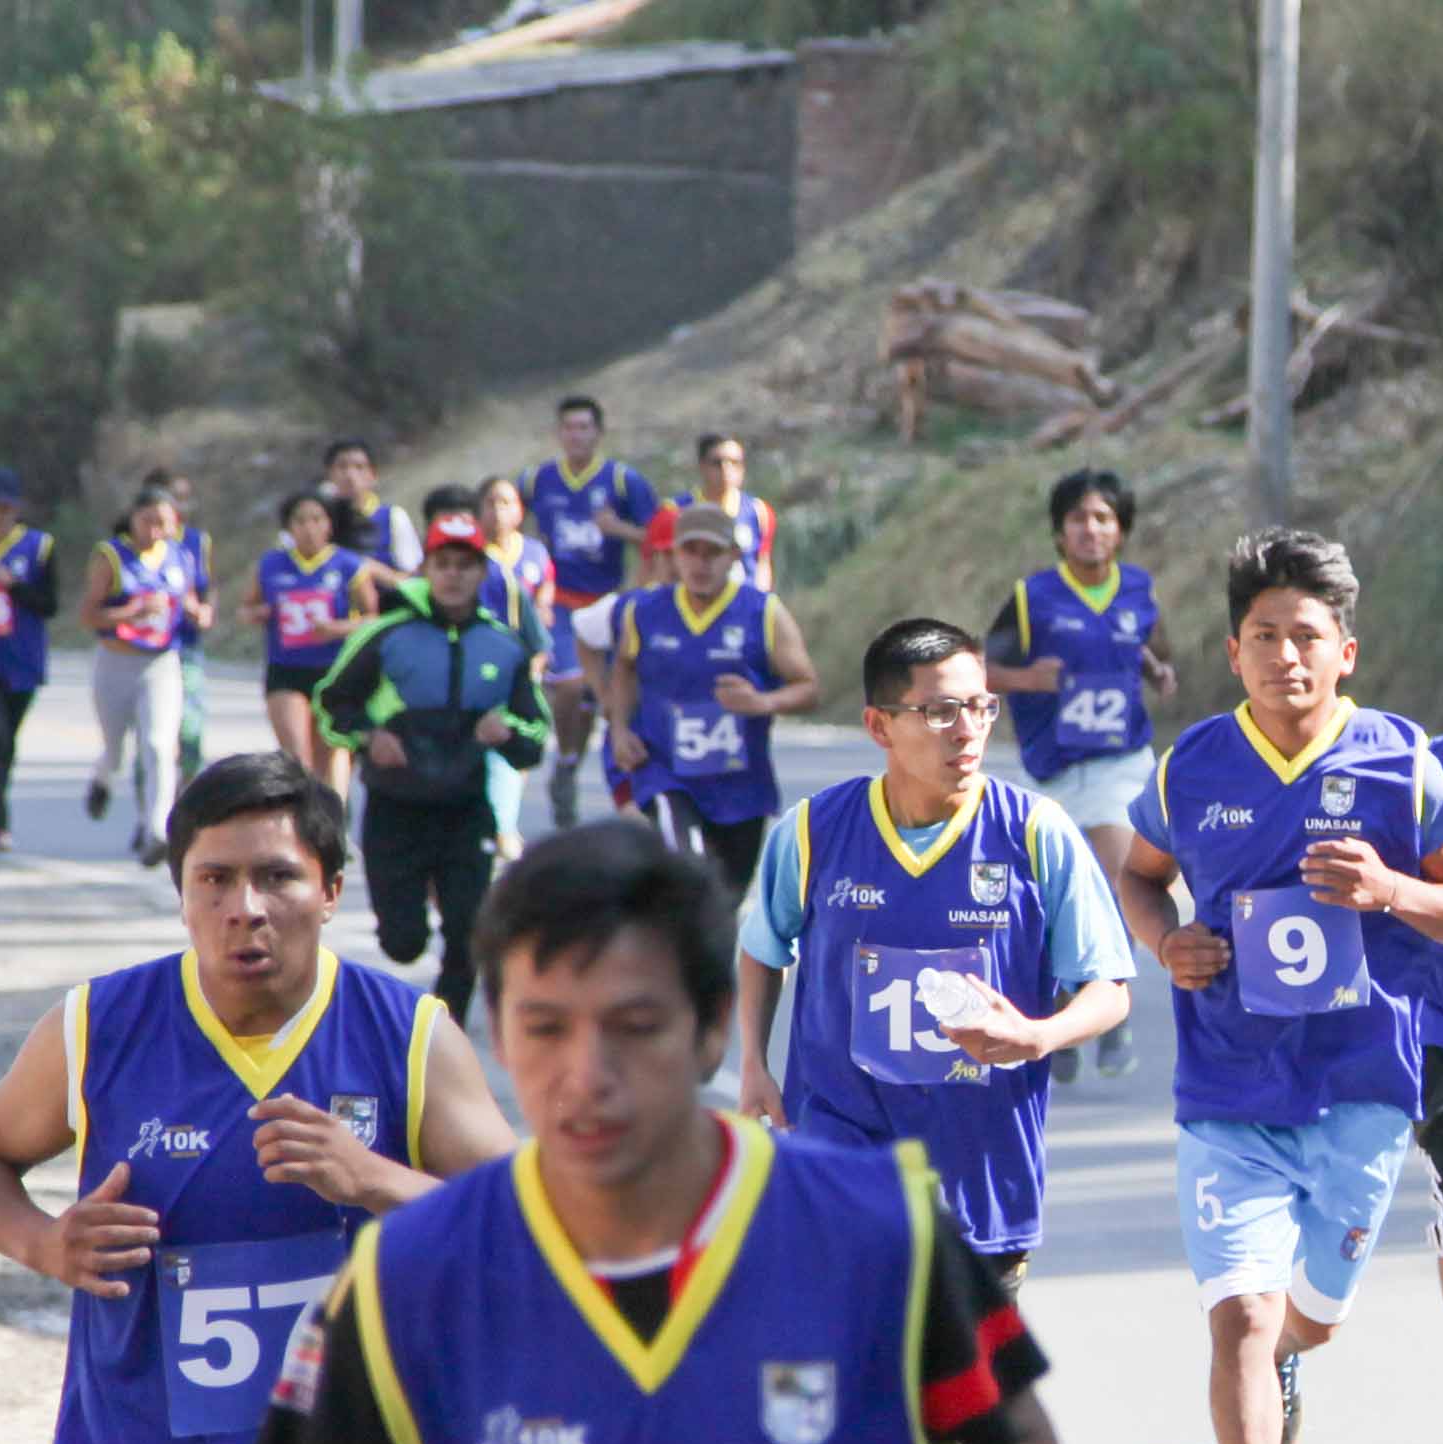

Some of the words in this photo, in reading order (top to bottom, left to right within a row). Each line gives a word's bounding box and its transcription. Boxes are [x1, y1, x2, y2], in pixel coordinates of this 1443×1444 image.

[1062, 689, 1126, 732] 42
[676, 715, 743, 760] 54
[1221, 808, 1254, 825] 10K
[1305, 818, 1362, 832] UNASAM
[850, 889, 885, 905] 10K
[949, 910, 1010, 923] UNASAM
[1268, 915, 1327, 987] 9
[160, 1130, 211, 1152] 10K
[1196, 1173, 1222, 1232] 5
[178, 1274, 337, 1388] 57
